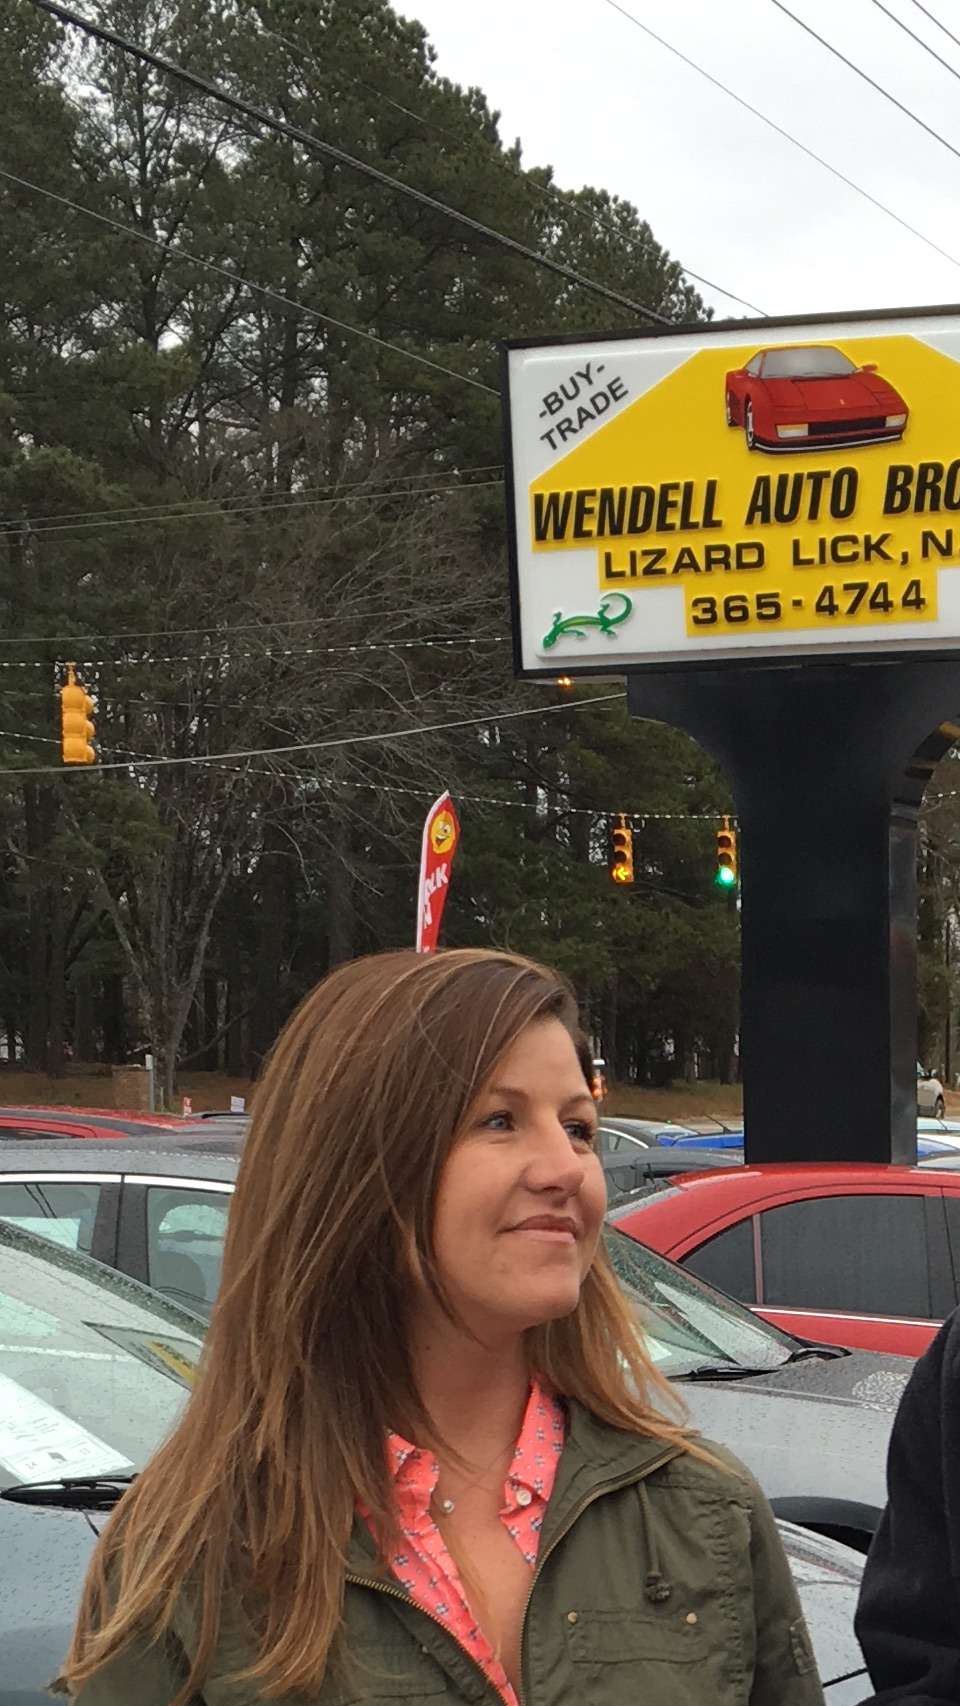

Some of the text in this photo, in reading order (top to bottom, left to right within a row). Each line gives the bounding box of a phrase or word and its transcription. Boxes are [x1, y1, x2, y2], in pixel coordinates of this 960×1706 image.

[539, 377, 629, 452] TRADE
[533, 479, 723, 541] WENDELL
[745, 467, 859, 526] AUTO
[605, 541, 765, 579] LIZARD
[792, 532, 911, 568] LICK,
[691, 579, 927, 626] 365-4744
